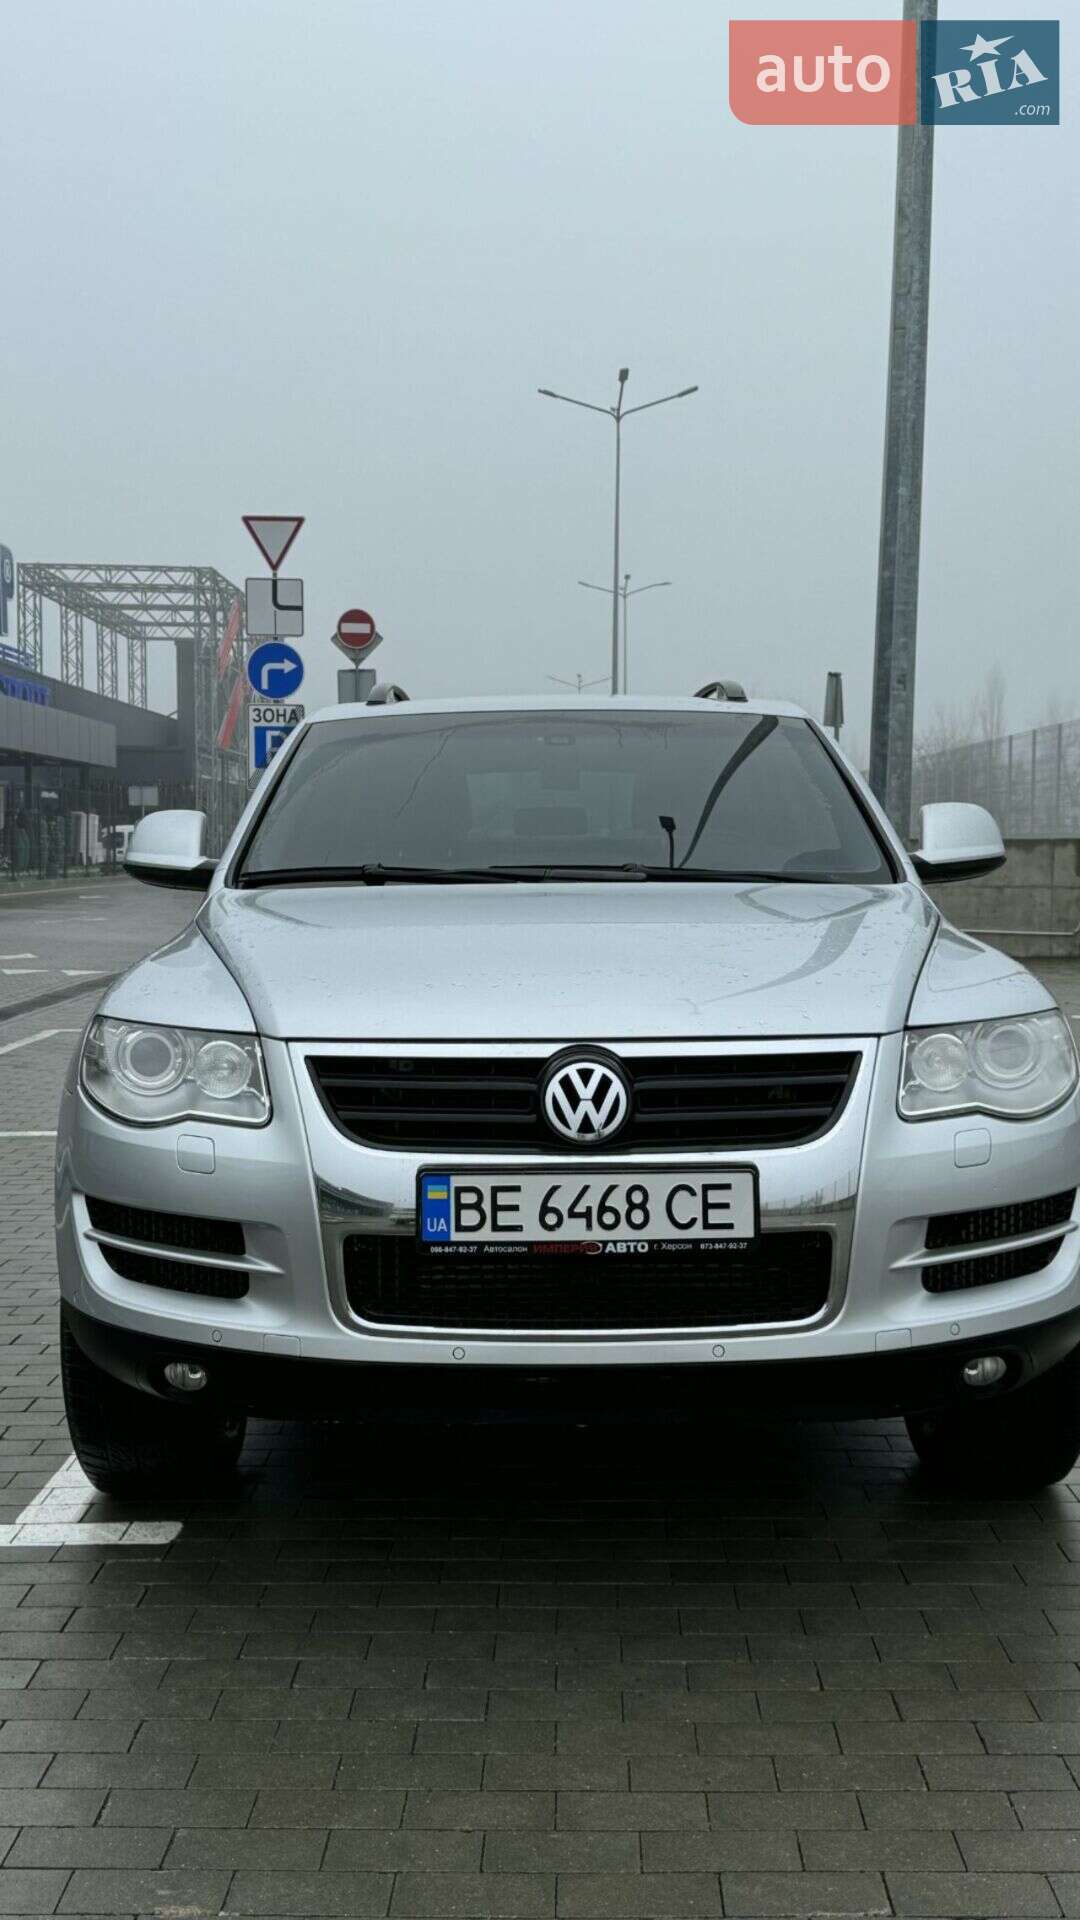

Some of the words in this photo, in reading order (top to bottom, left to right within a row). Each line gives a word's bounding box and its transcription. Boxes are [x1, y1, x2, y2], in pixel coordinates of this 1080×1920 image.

[252, 707, 301, 723] ЗОНА
[454, 1185, 524, 1232] BE
[538, 1184, 650, 1232] 6468
[665, 1183, 735, 1231] CE
[427, 1217, 448, 1232] UA
[483, 1244, 529, 1254] Автосалон
[604, 1241, 649, 1254] АВТО
